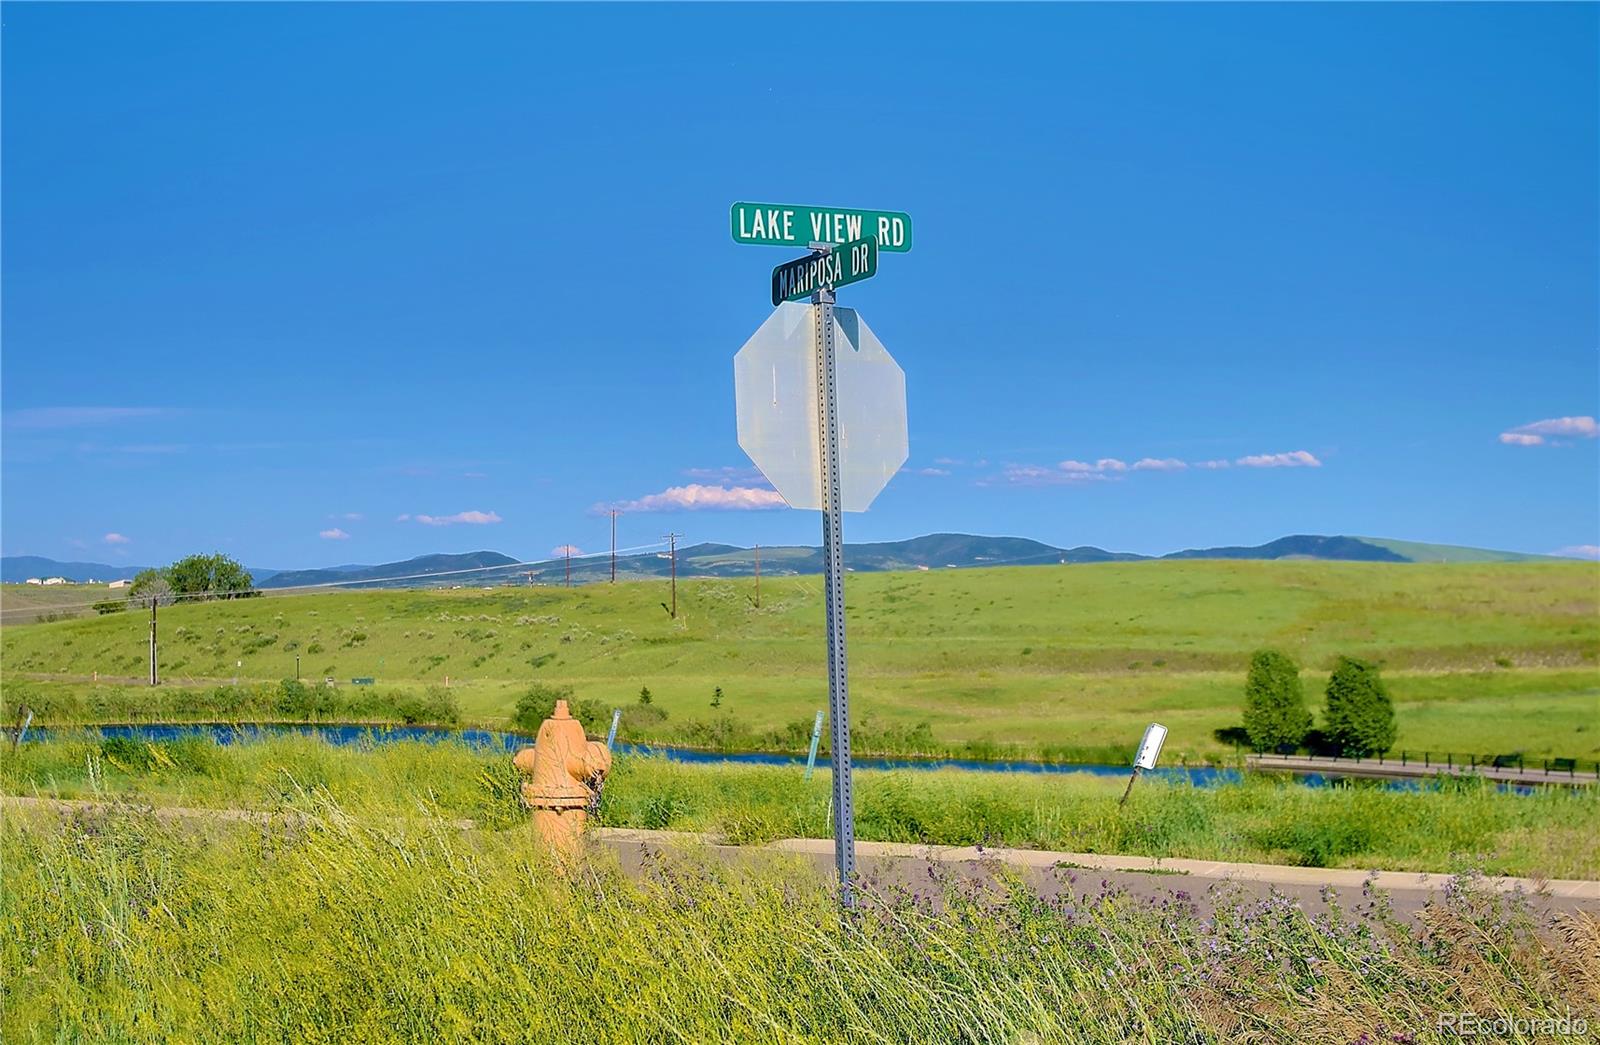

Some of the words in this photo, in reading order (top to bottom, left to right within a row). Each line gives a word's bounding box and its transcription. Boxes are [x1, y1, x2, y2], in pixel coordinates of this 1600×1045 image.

[739, 208, 795, 241] LAKE
[810, 212, 862, 243] VIEW
[878, 217, 904, 247] RD
[779, 252, 842, 299] MARIPOSA
[852, 243, 868, 277] DR
